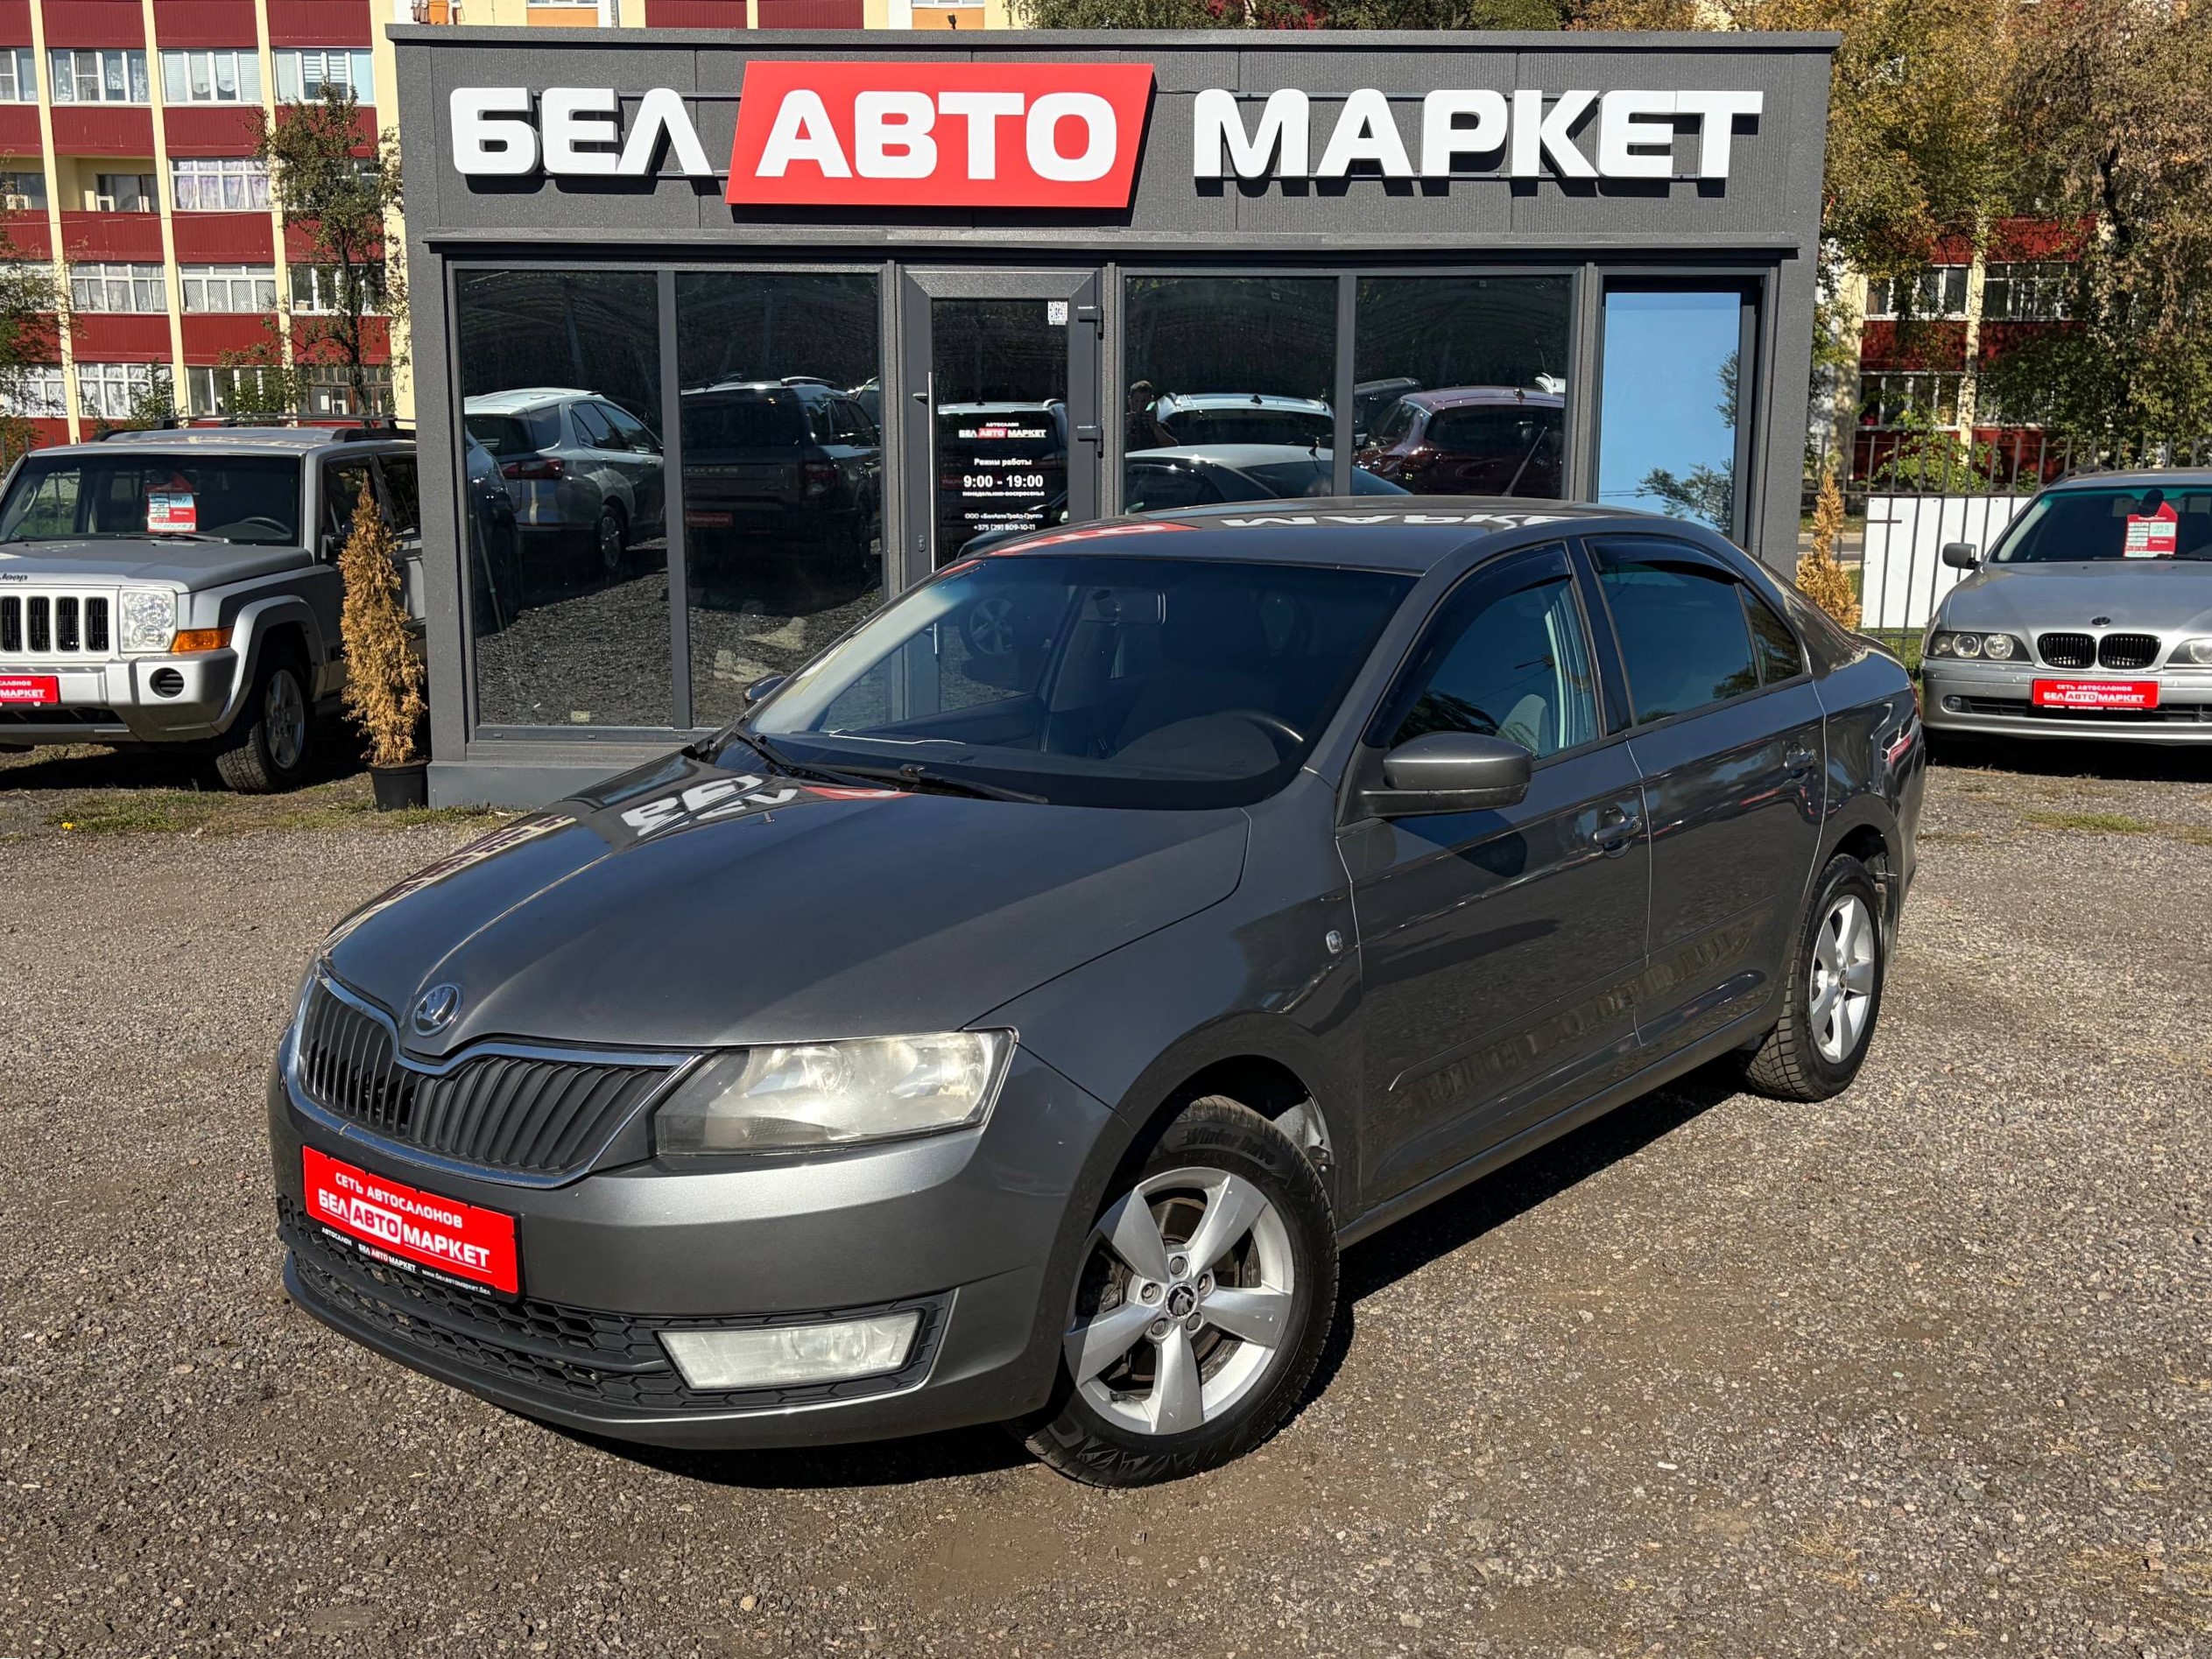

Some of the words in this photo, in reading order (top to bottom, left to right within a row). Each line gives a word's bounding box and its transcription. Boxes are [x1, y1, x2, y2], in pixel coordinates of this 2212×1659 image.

[450, 88, 715, 175] БЕЛ
[754, 88, 1117, 182] АВТО
[1194, 88, 1764, 179] МАРКЕТ
[958, 429, 977, 438] БЕЛ
[1007, 429, 1046, 438] МАРКЕТ
[1002, 457, 1032, 467] работы
[963, 475, 993, 488] 9:00
[1006, 475, 1044, 488] 19:00
[1, 689, 46, 698] МАРКЕТ
[2043, 692, 2065, 701] БЕЛ
[2066, 692, 2096, 701] АВТО
[2098, 693, 2145, 703] МАРКЕТ
[335, 1172, 363, 1194] СЕТЬ
[366, 1185, 463, 1228] АВТОСАЛОНОВ
[318, 1188, 349, 1219] БЕЛ
[352, 1204, 400, 1240] АВТО
[403, 1223, 490, 1268] МАРКЕТ
[321, 1227, 352, 1247] АВТОСАЛОН
[358, 1243, 370, 1256] БЕЛ
[370, 1248, 390, 1262] АВТО
[389, 1256, 417, 1273] МАРКЕТ
